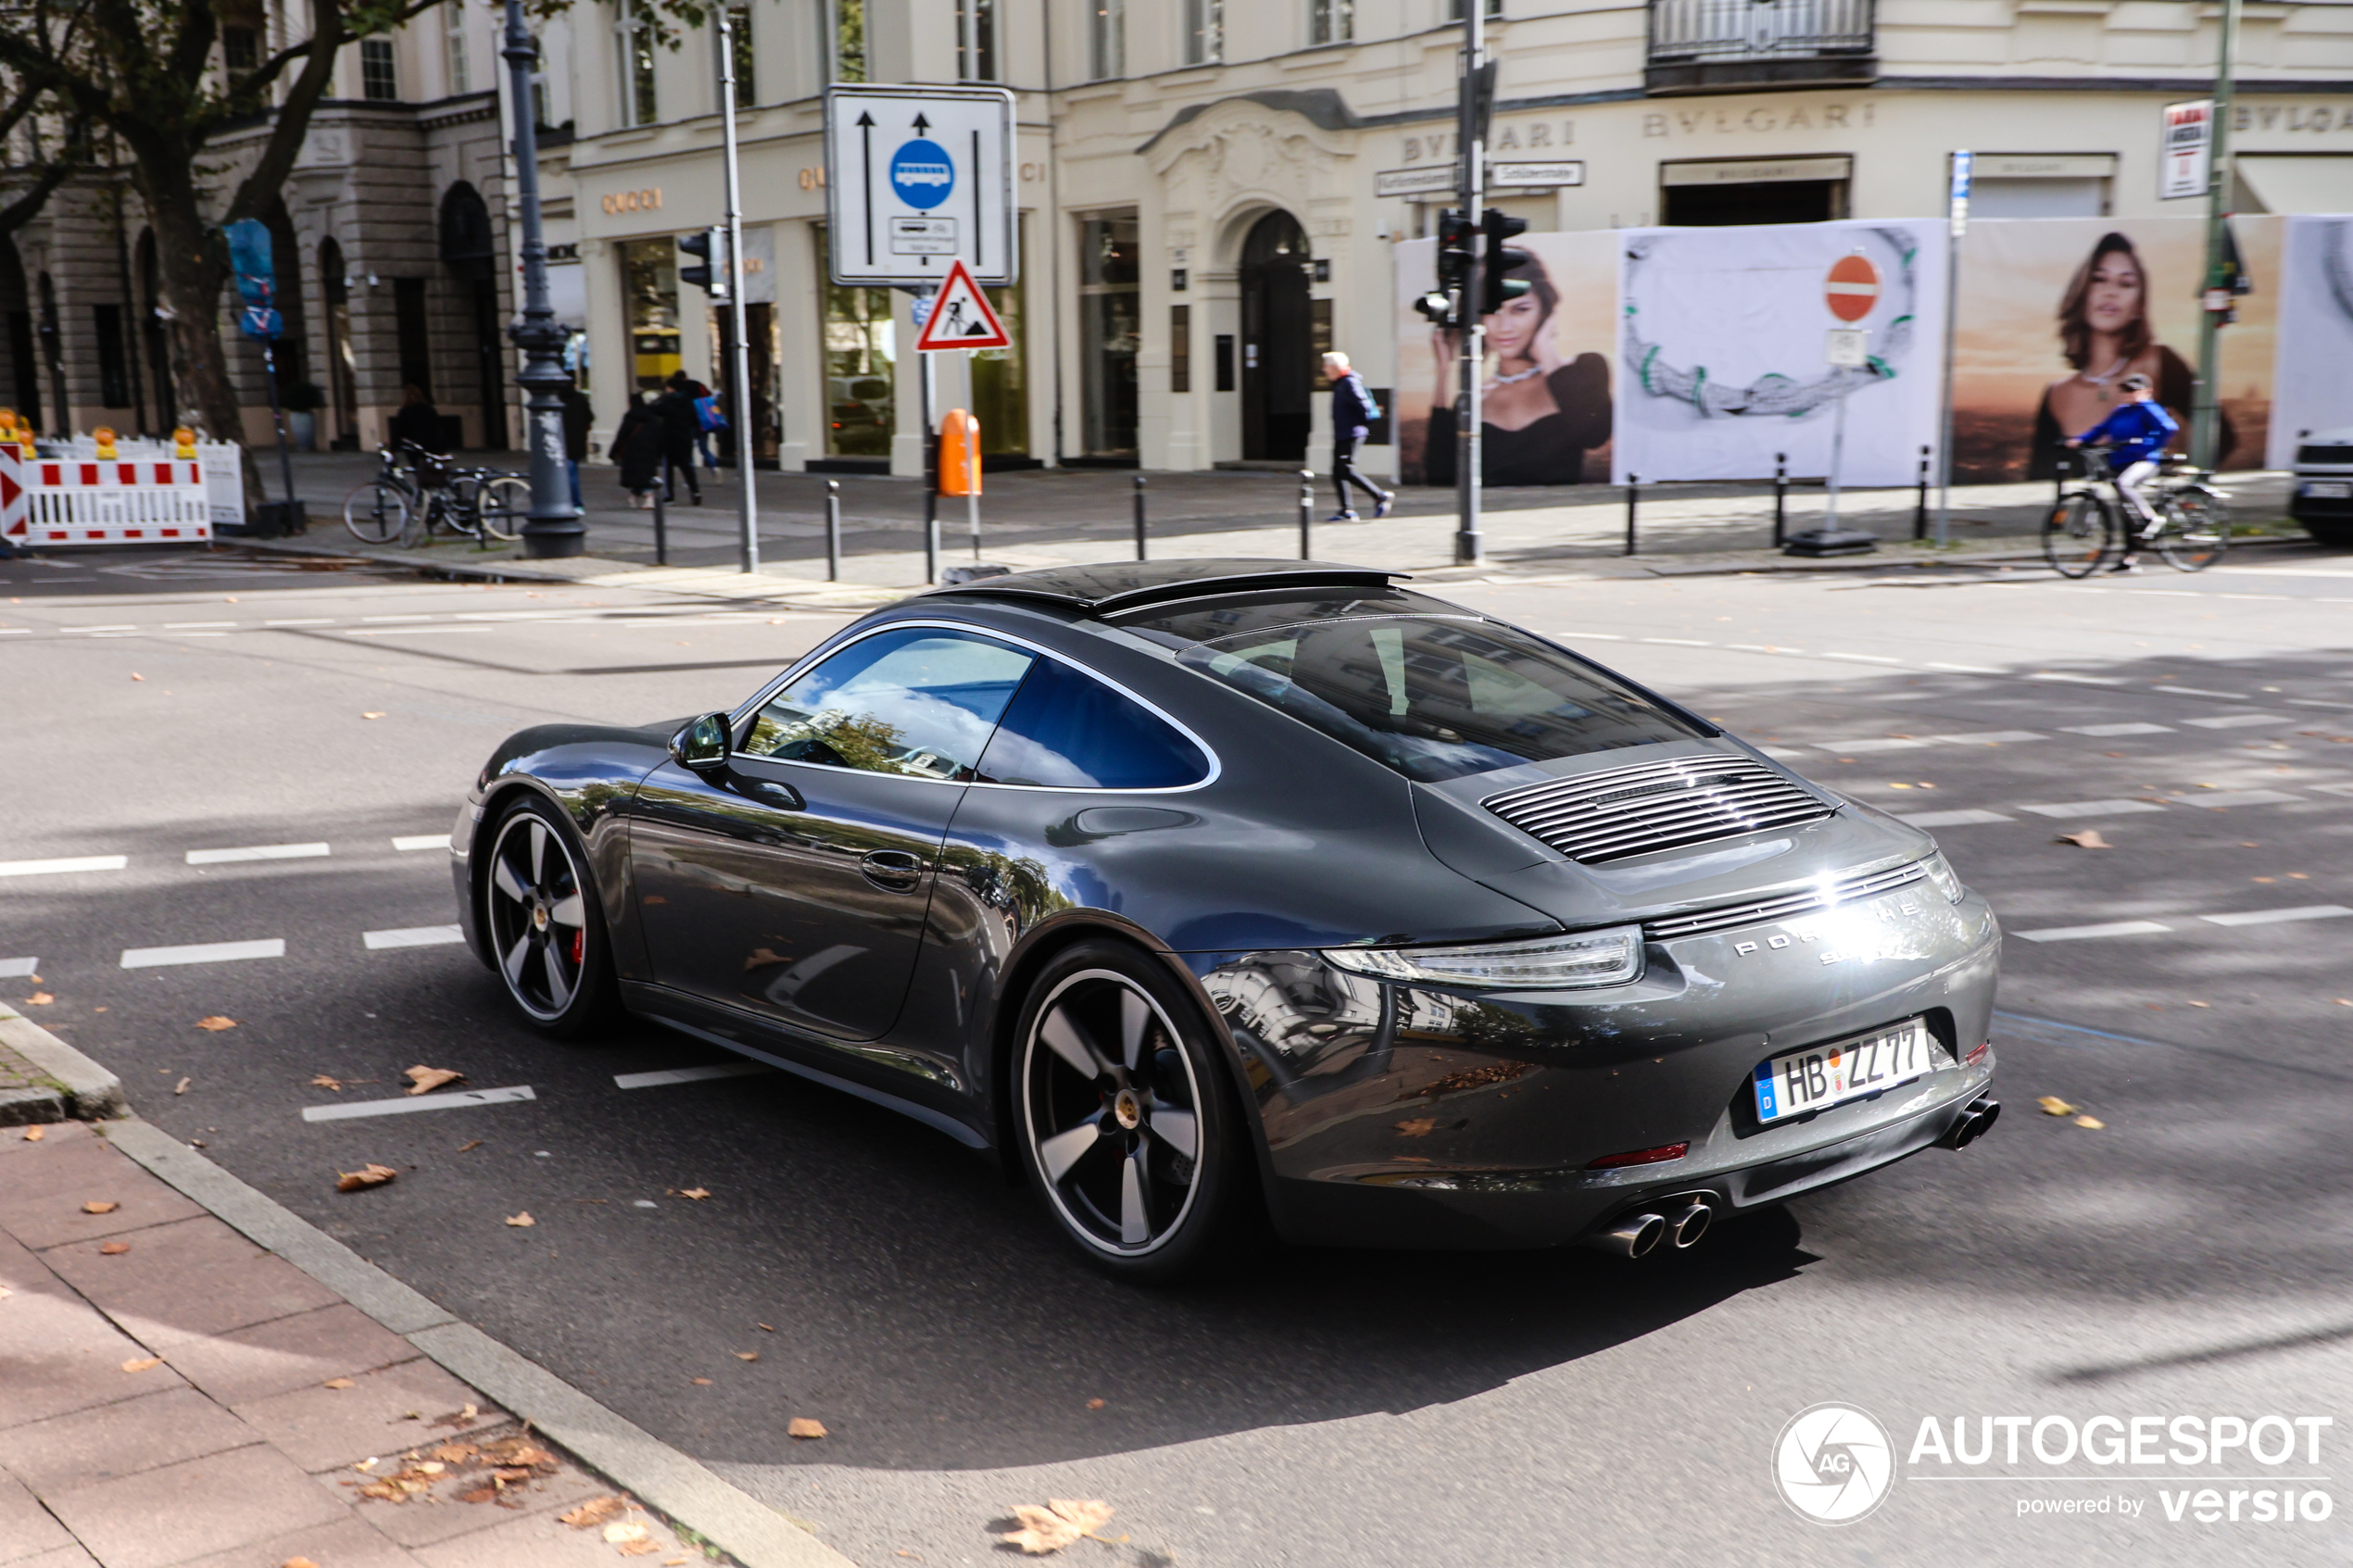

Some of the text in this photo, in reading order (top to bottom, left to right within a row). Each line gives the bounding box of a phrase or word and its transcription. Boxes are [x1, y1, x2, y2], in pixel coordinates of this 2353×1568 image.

[1642, 103, 1876, 138] BVLGARI
[1403, 121, 1576, 162] BVARI
[601, 187, 662, 215] GUCCI
[1733, 902, 1919, 958] PORHE
[1785, 1023, 1917, 1107] HB ZZ 77
[1763, 1096, 1772, 1110] D
